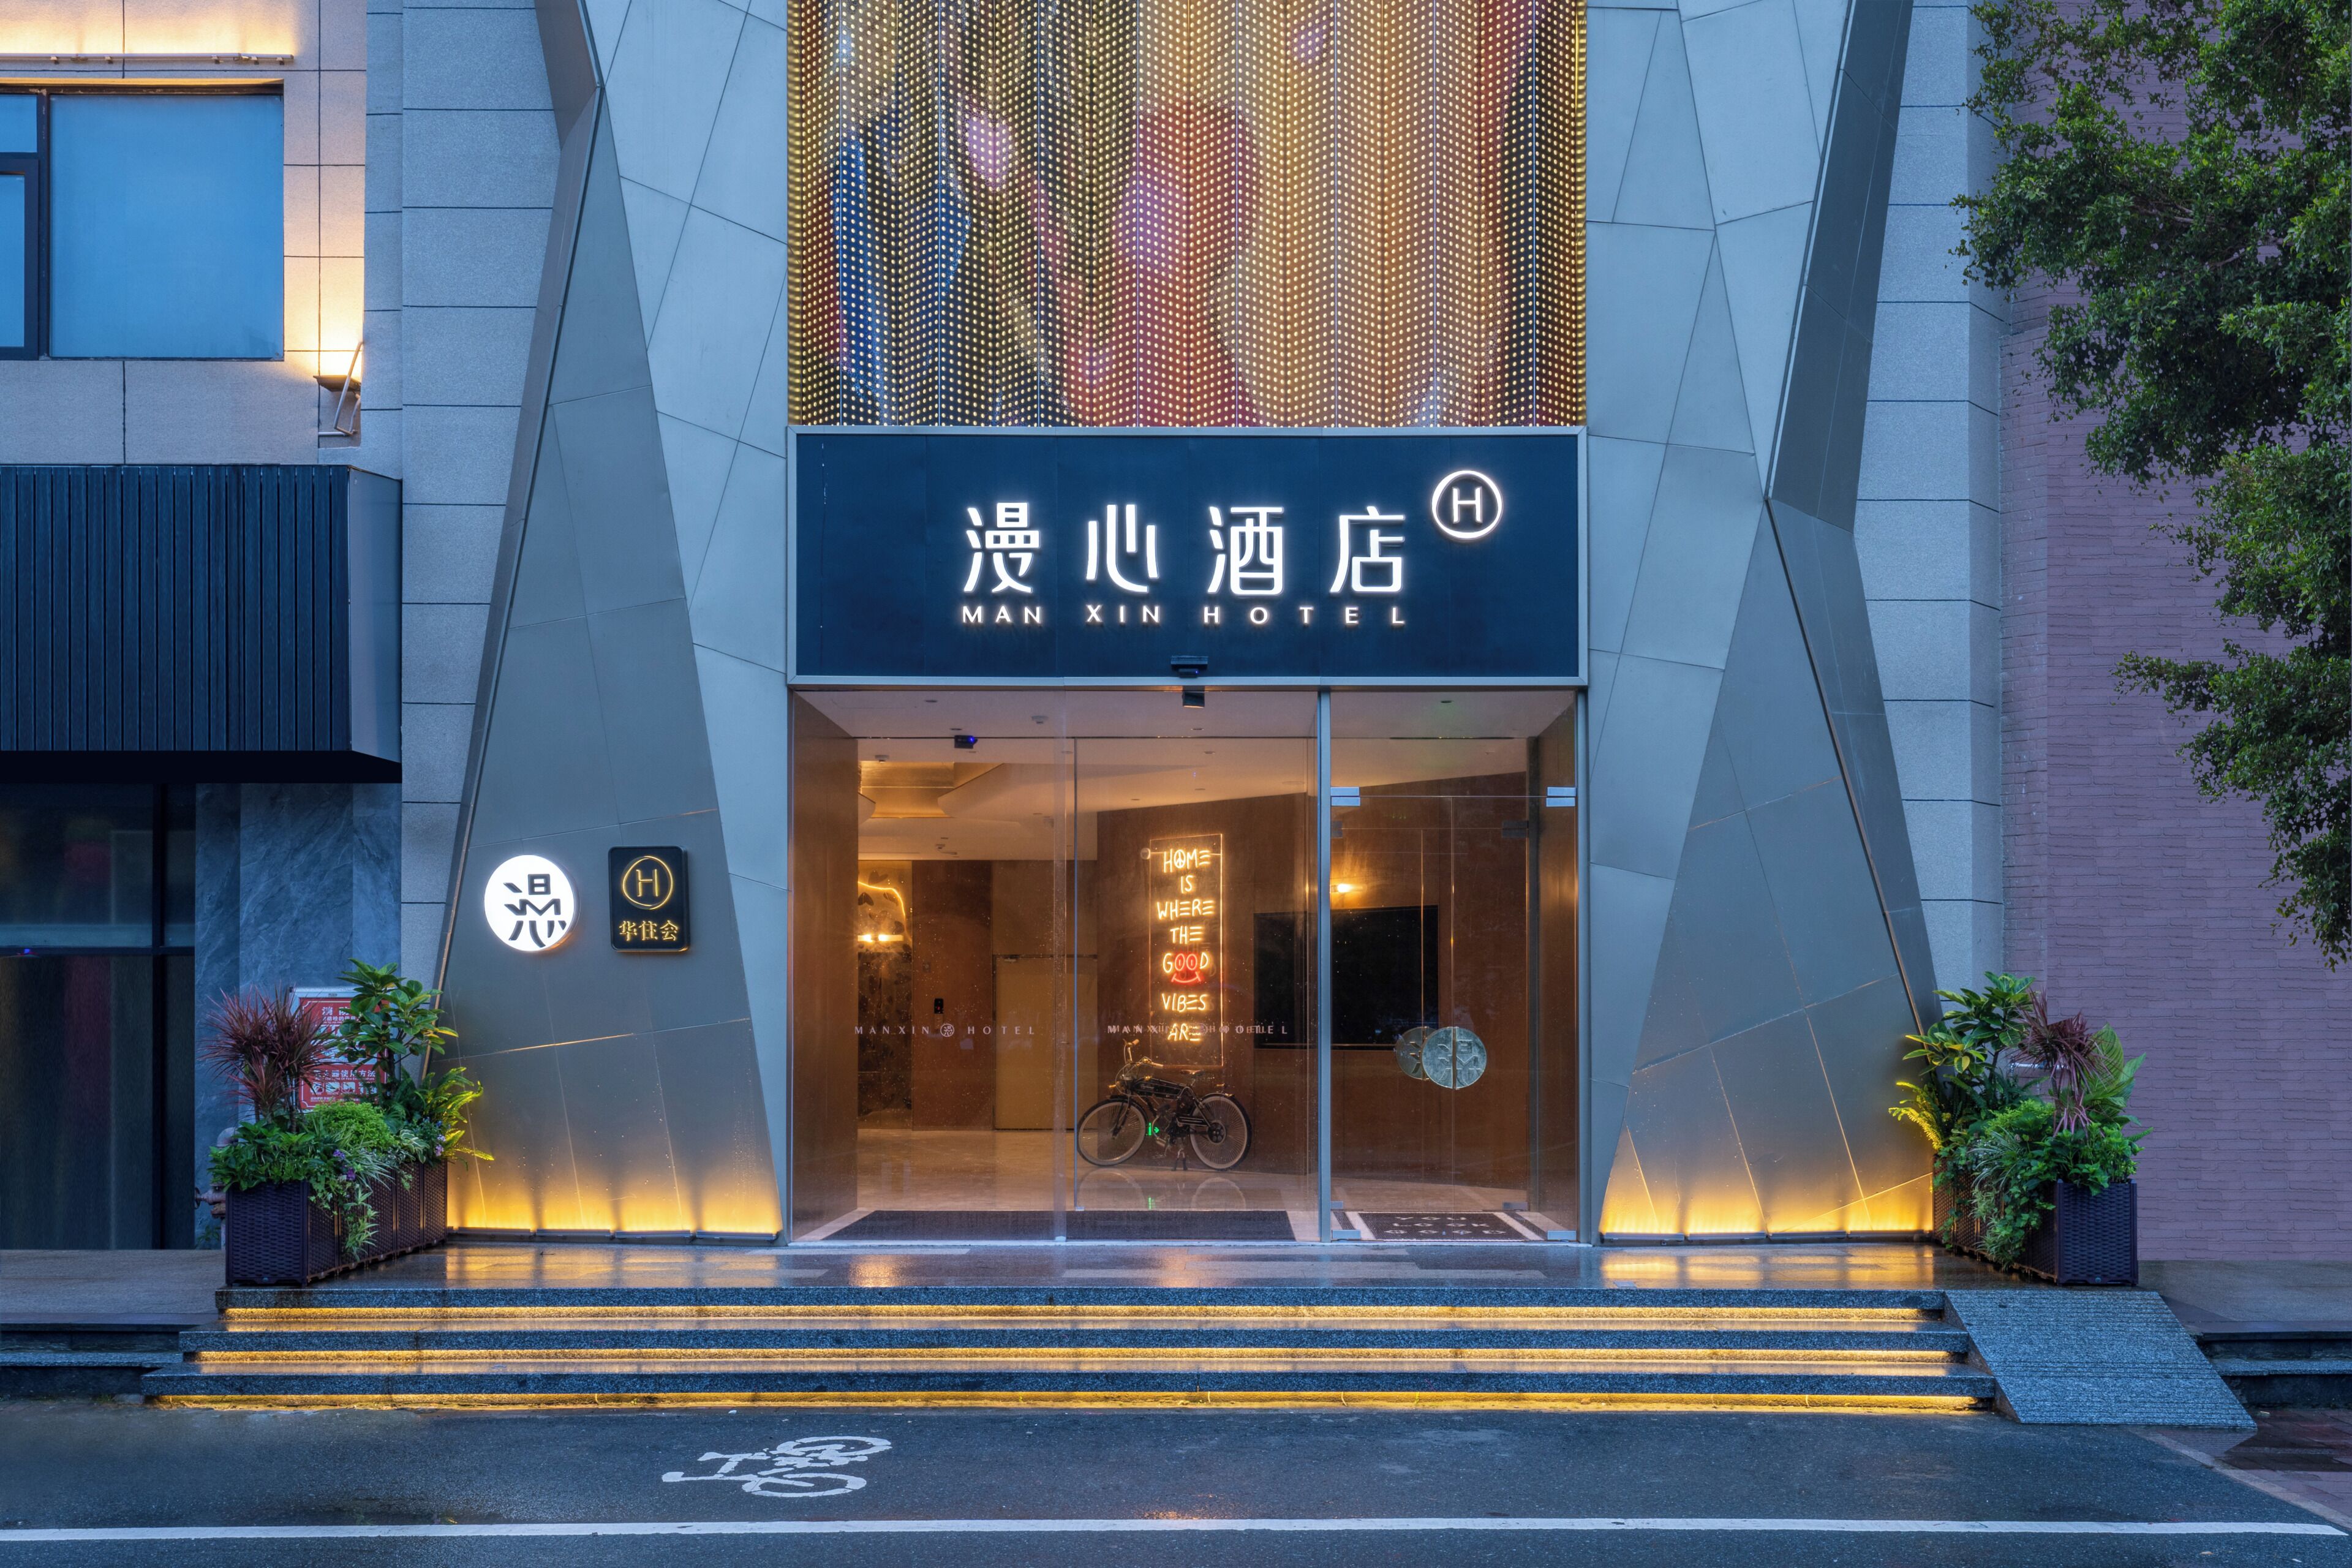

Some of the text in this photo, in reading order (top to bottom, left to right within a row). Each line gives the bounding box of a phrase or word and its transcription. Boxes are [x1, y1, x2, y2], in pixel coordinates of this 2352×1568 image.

[963, 502, 1407, 596] 漫心酒店
[962, 604, 1405, 625] MAN XIN HOTEL
[1164, 848, 1212, 873] HOME
[1181, 875, 1194, 894] IS
[1156, 899, 1215, 920] WHERE
[619, 920, 679, 941] 华住会
[1170, 925, 1202, 944] THE
[1163, 952, 1209, 973] GOOD
[1162, 993, 1207, 1012] VIBES
[967, 1026, 1035, 1035] HOTEL
[1167, 1023, 1201, 1041] ARE
